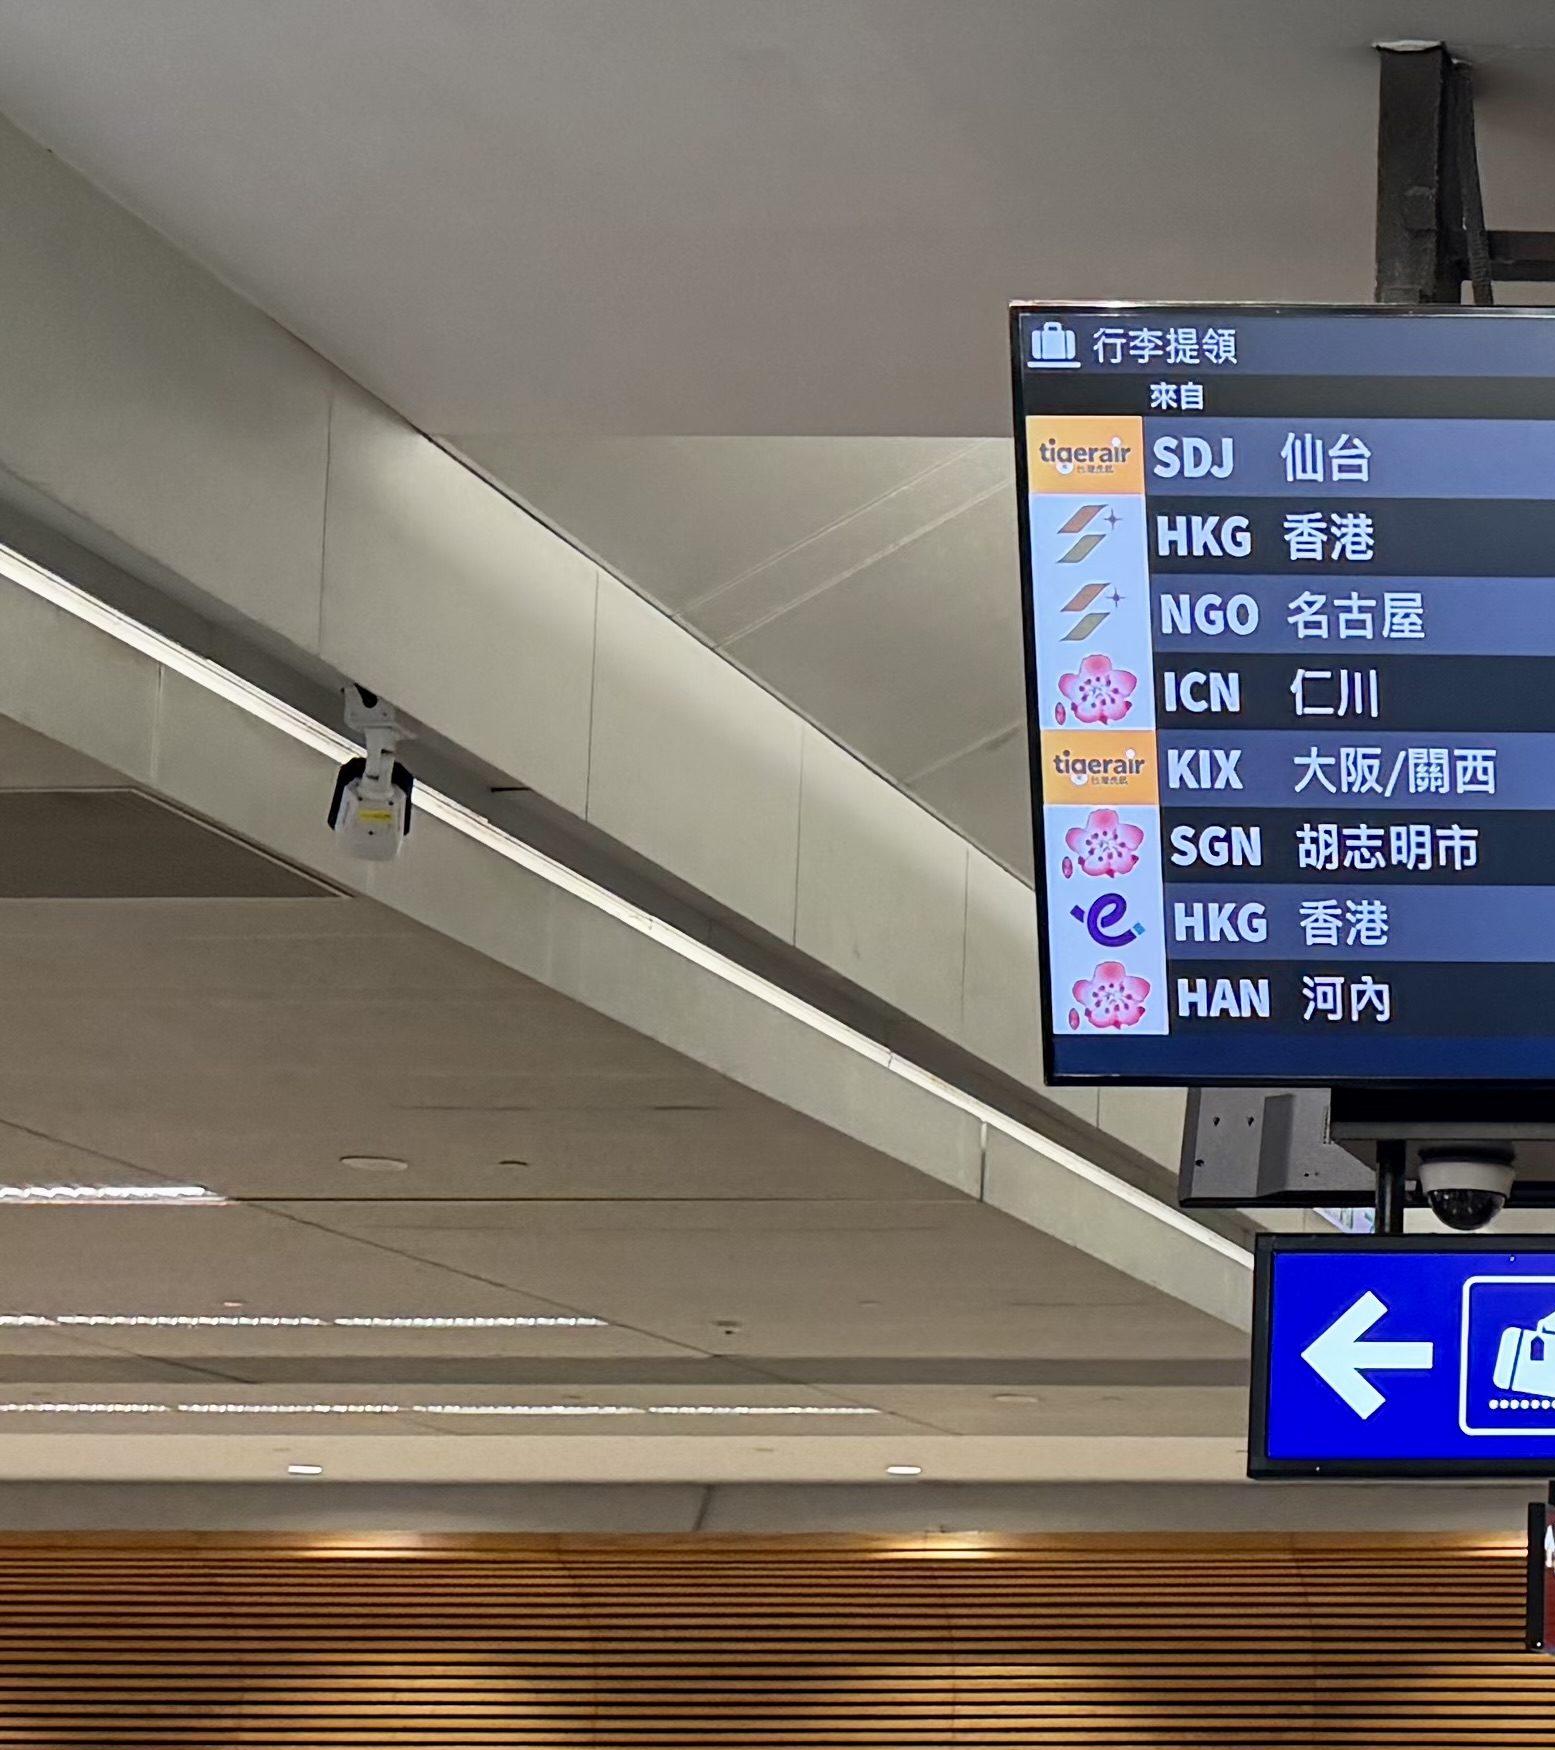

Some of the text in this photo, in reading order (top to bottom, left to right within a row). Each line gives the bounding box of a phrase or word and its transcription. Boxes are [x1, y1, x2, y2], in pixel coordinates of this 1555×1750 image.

[1093, 327, 1238, 365] 行李提領
[1149, 381, 1204, 410] 來自
[1039, 436, 1131, 468] tigerair
[1153, 431, 1372, 483] SDJ 仙台
[1156, 511, 1375, 561] HKG 香港
[1160, 590, 1426, 640] NGO 名古屋
[1163, 668, 1379, 718] ICN 仁川
[1167, 746, 1497, 798] KIX 大阪/關西
[1170, 823, 1479, 871] SGN 胡志明市
[1173, 899, 1389, 946] HKG 香港
[1177, 975, 1391, 1022] HAN 河內
